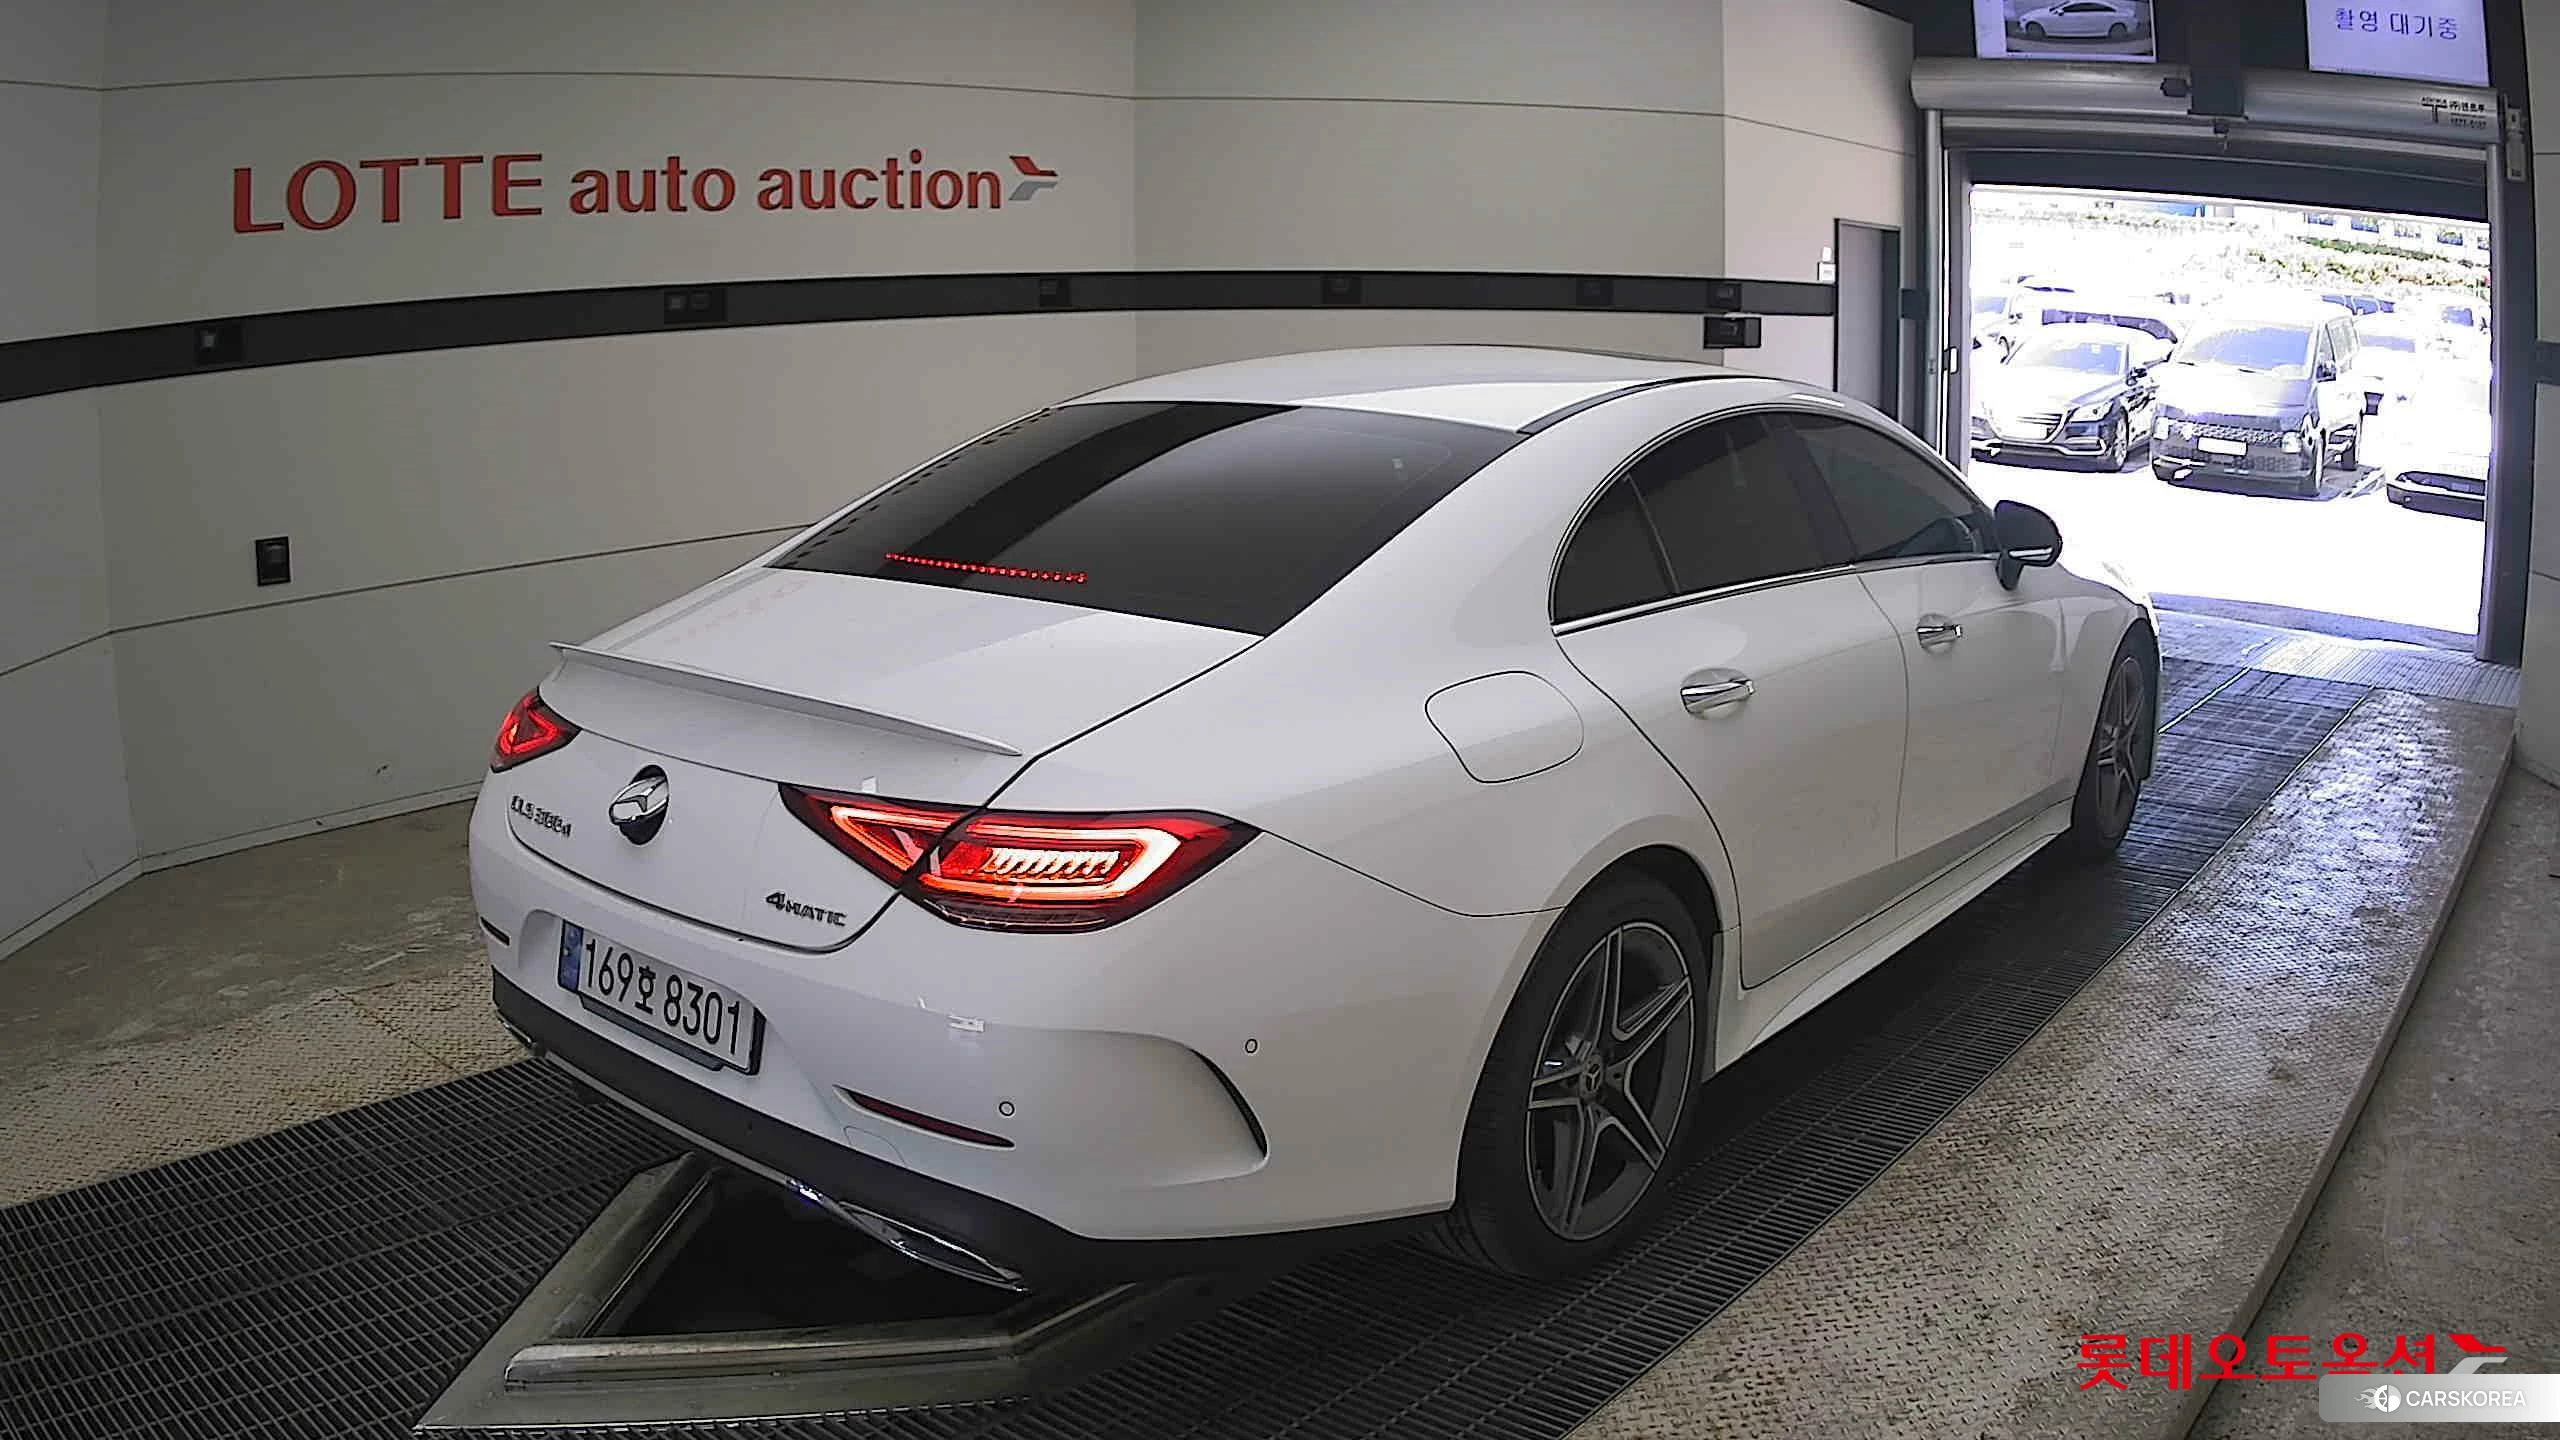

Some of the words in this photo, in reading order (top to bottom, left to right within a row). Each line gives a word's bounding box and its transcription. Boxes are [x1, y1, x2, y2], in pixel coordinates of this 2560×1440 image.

[2335, 7, 2379, 33] 촬영
[2389, 12, 2458, 40] 대기중
[233, 153, 543, 233] LOTTE
[570, 157, 737, 214] auto
[757, 150, 1002, 211] auction
[765, 891, 847, 928] 4MATIC
[584, 937, 657, 1016] 169호
[663, 974, 741, 1056] 8301
